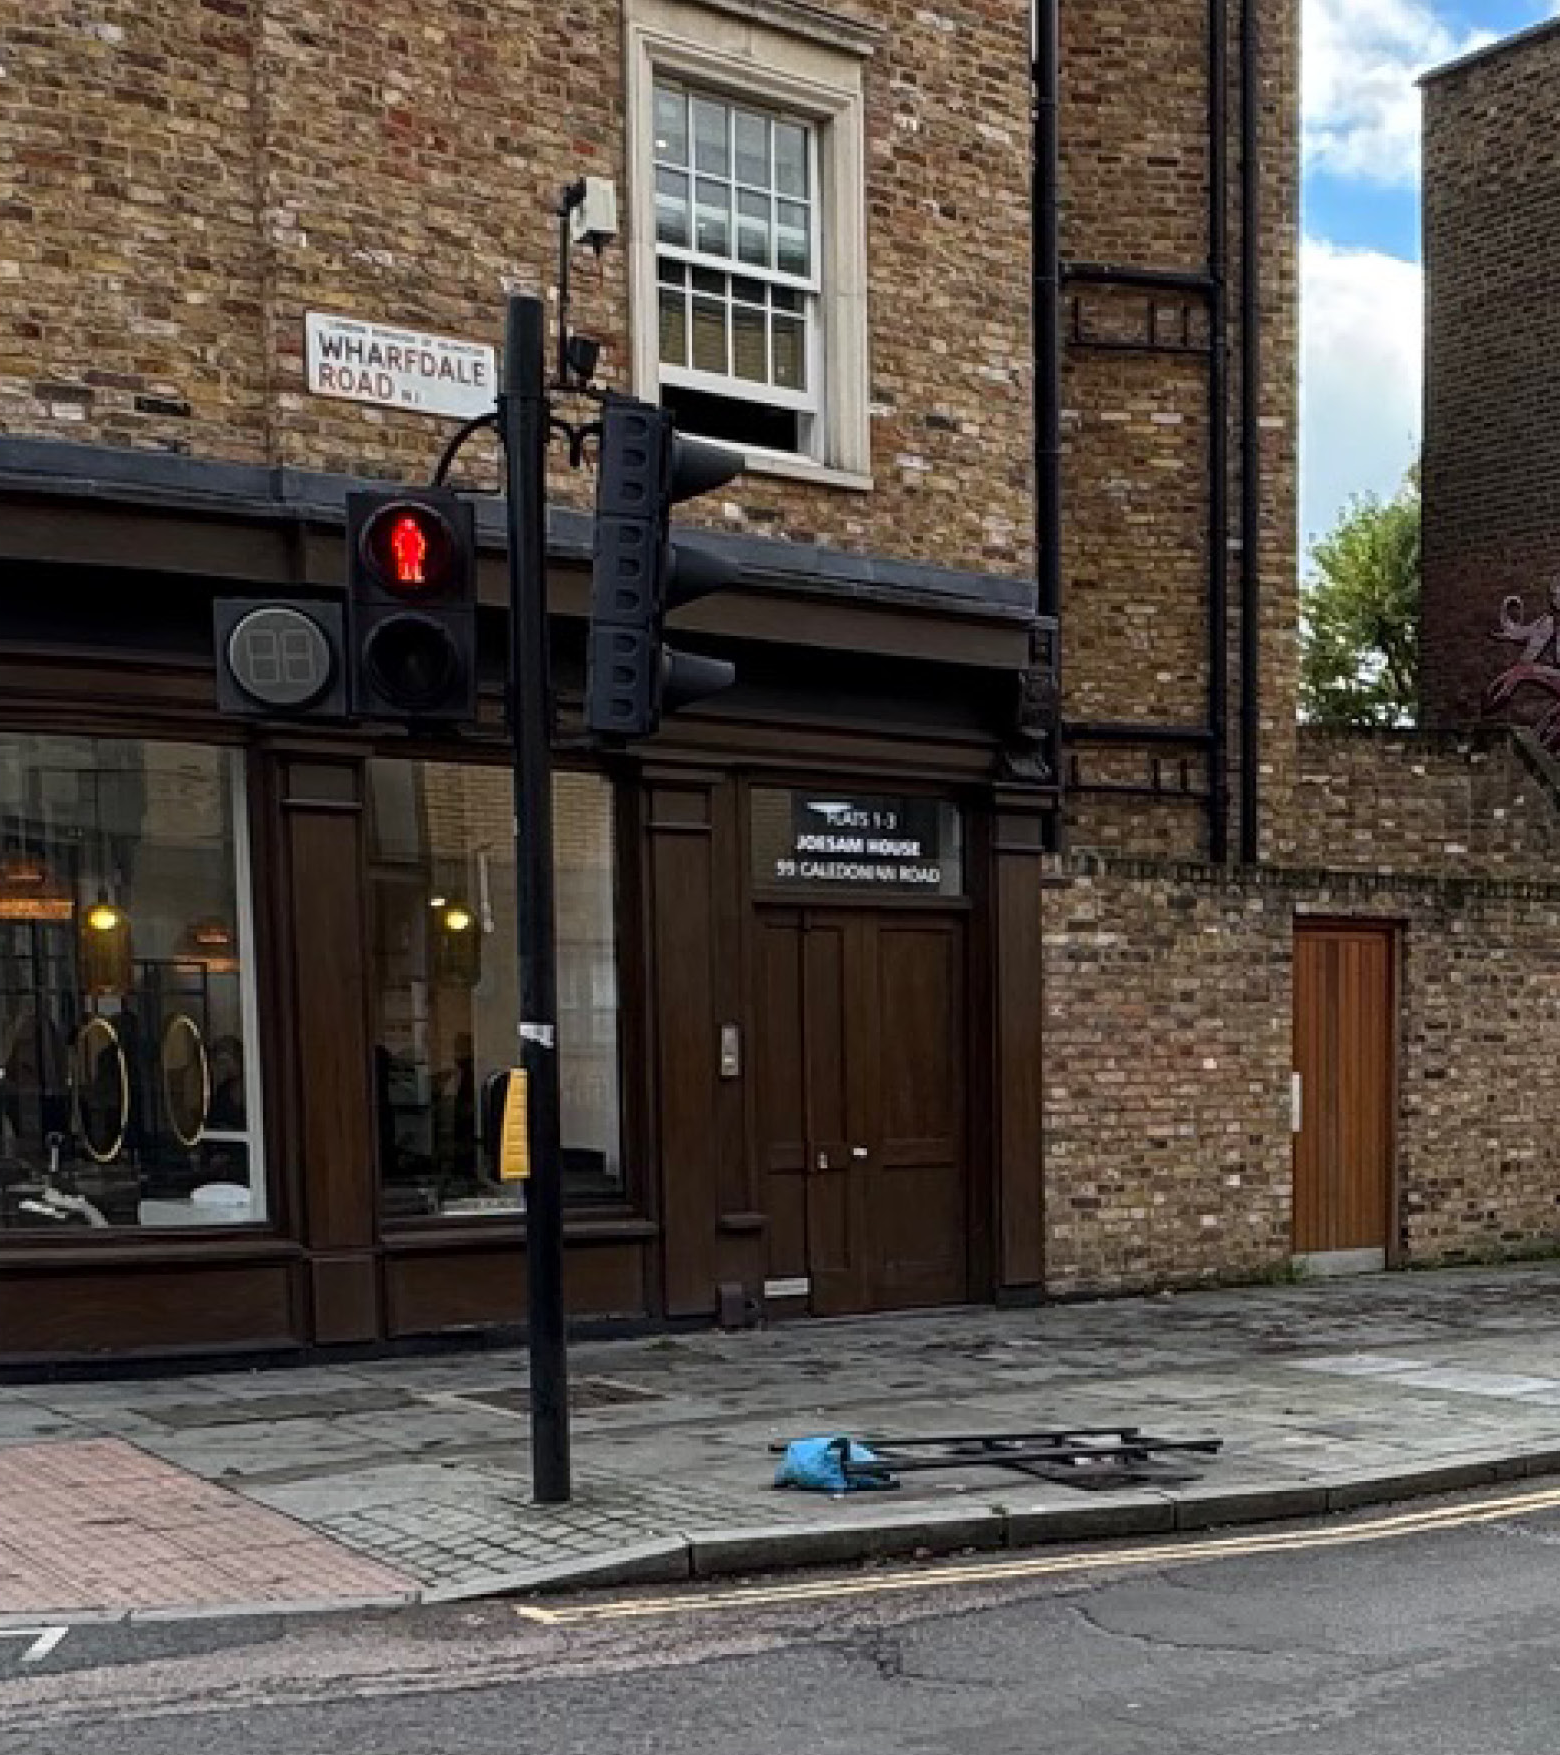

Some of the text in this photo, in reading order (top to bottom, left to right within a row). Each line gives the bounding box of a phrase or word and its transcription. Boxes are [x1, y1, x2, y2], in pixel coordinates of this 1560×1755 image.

[318, 330, 487, 387] WHARFDALE
[318, 363, 395, 400] ROAD
[797, 834, 921, 856] JOESAM HOUSE
[801, 861, 897, 880] CALEDONIAN
[900, 864, 940, 883] ROAD
